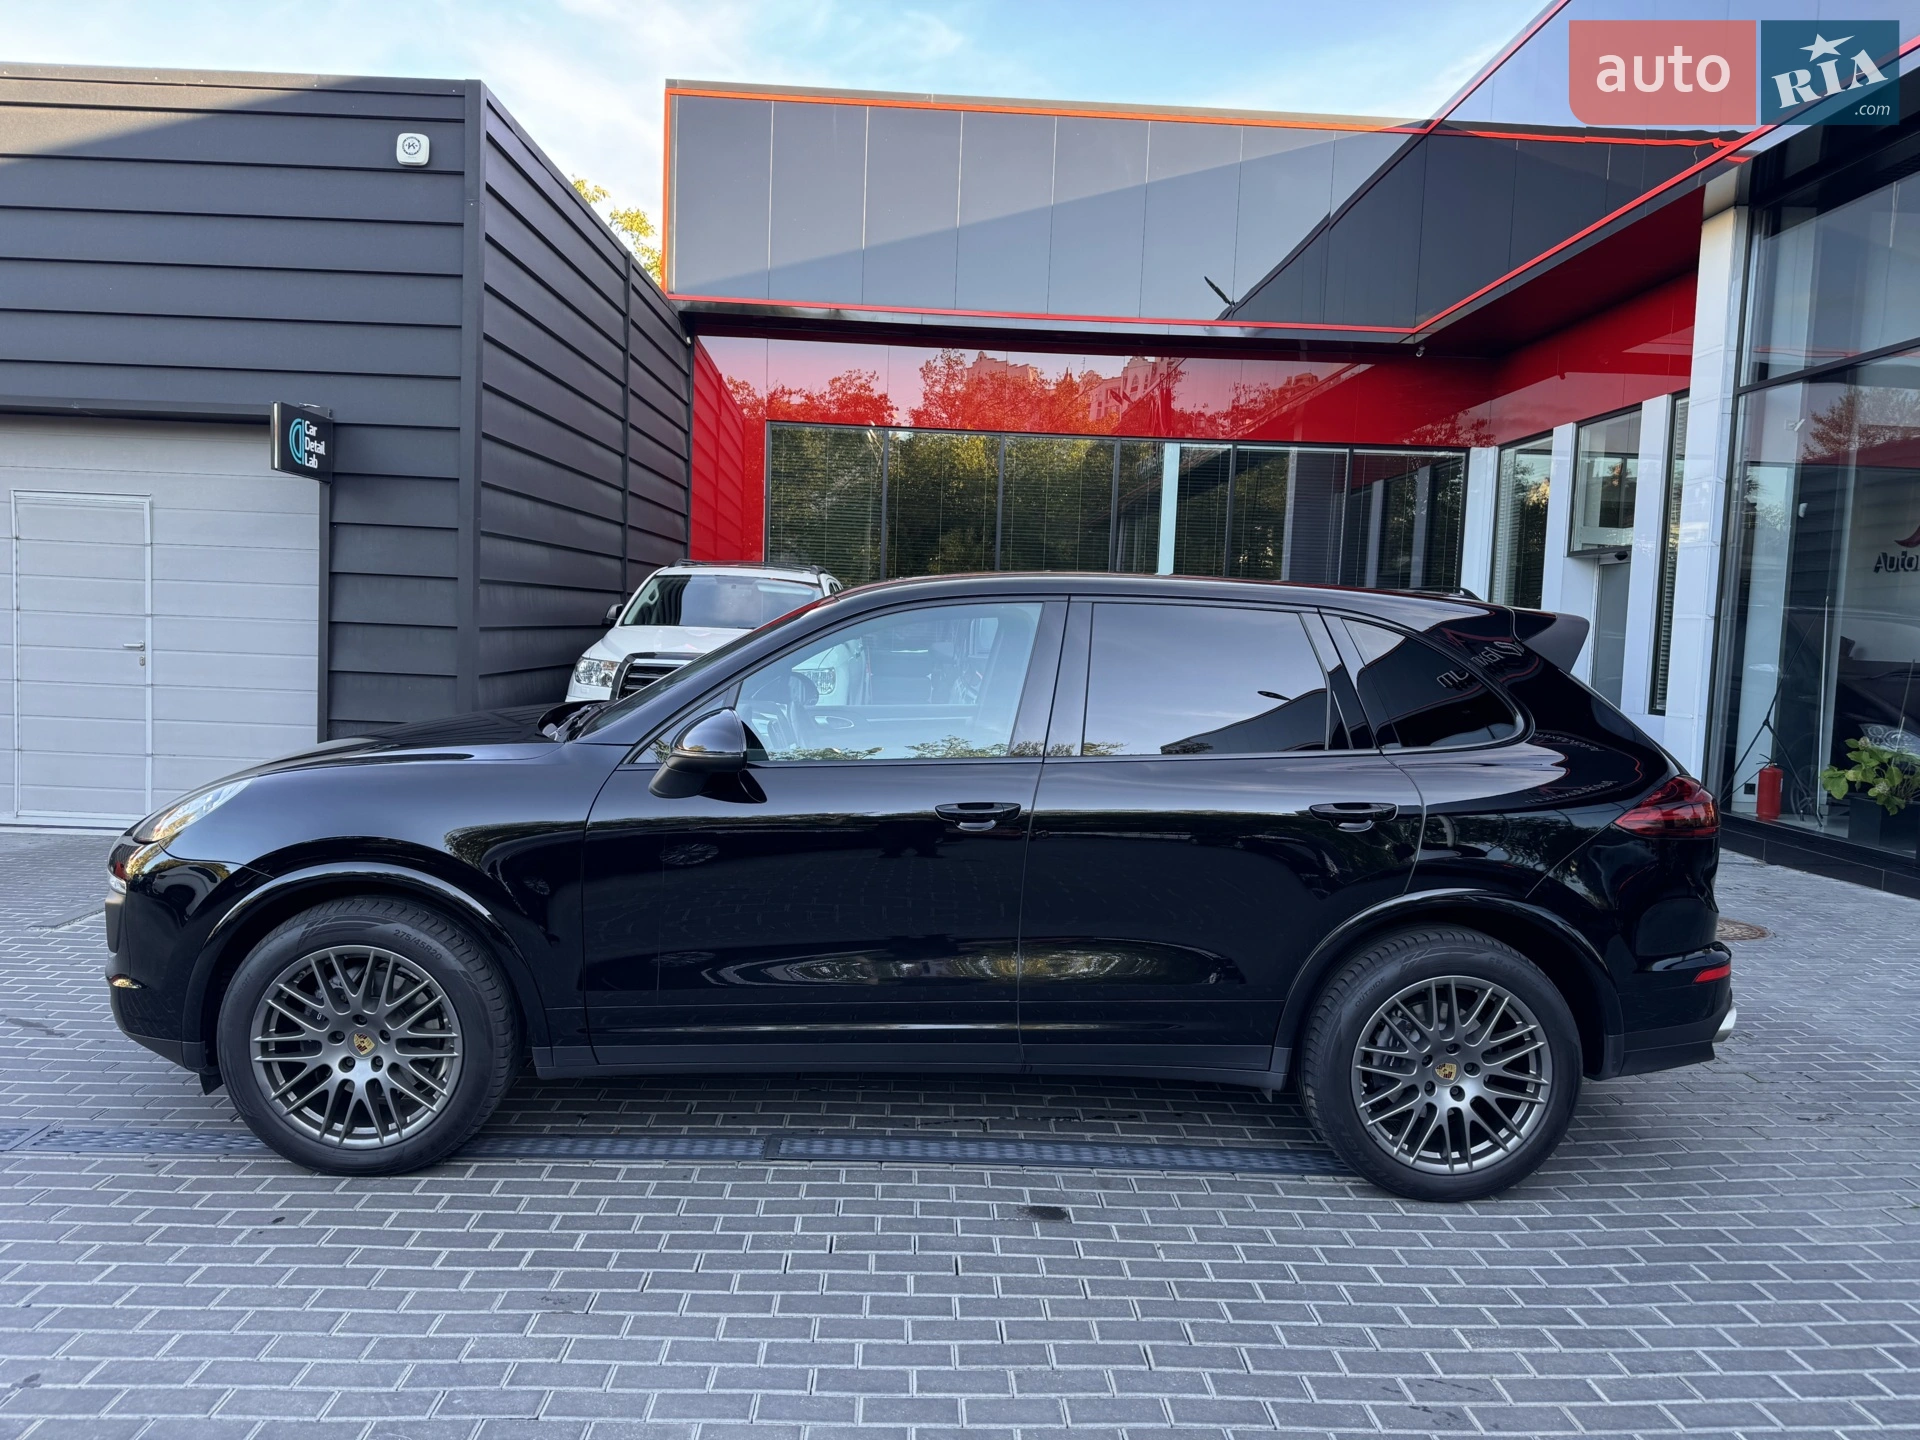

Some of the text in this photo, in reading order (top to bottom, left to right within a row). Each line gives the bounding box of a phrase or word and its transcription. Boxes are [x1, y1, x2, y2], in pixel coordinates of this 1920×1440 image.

[304, 420, 318, 436] Car
[304, 436, 326, 455] Detail
[304, 452, 319, 469] Lab
[1873, 550, 1920, 574] Auto
[393, 929, 443, 960] 275/45R20
[1354, 976, 1386, 1007] OUTSIDE
